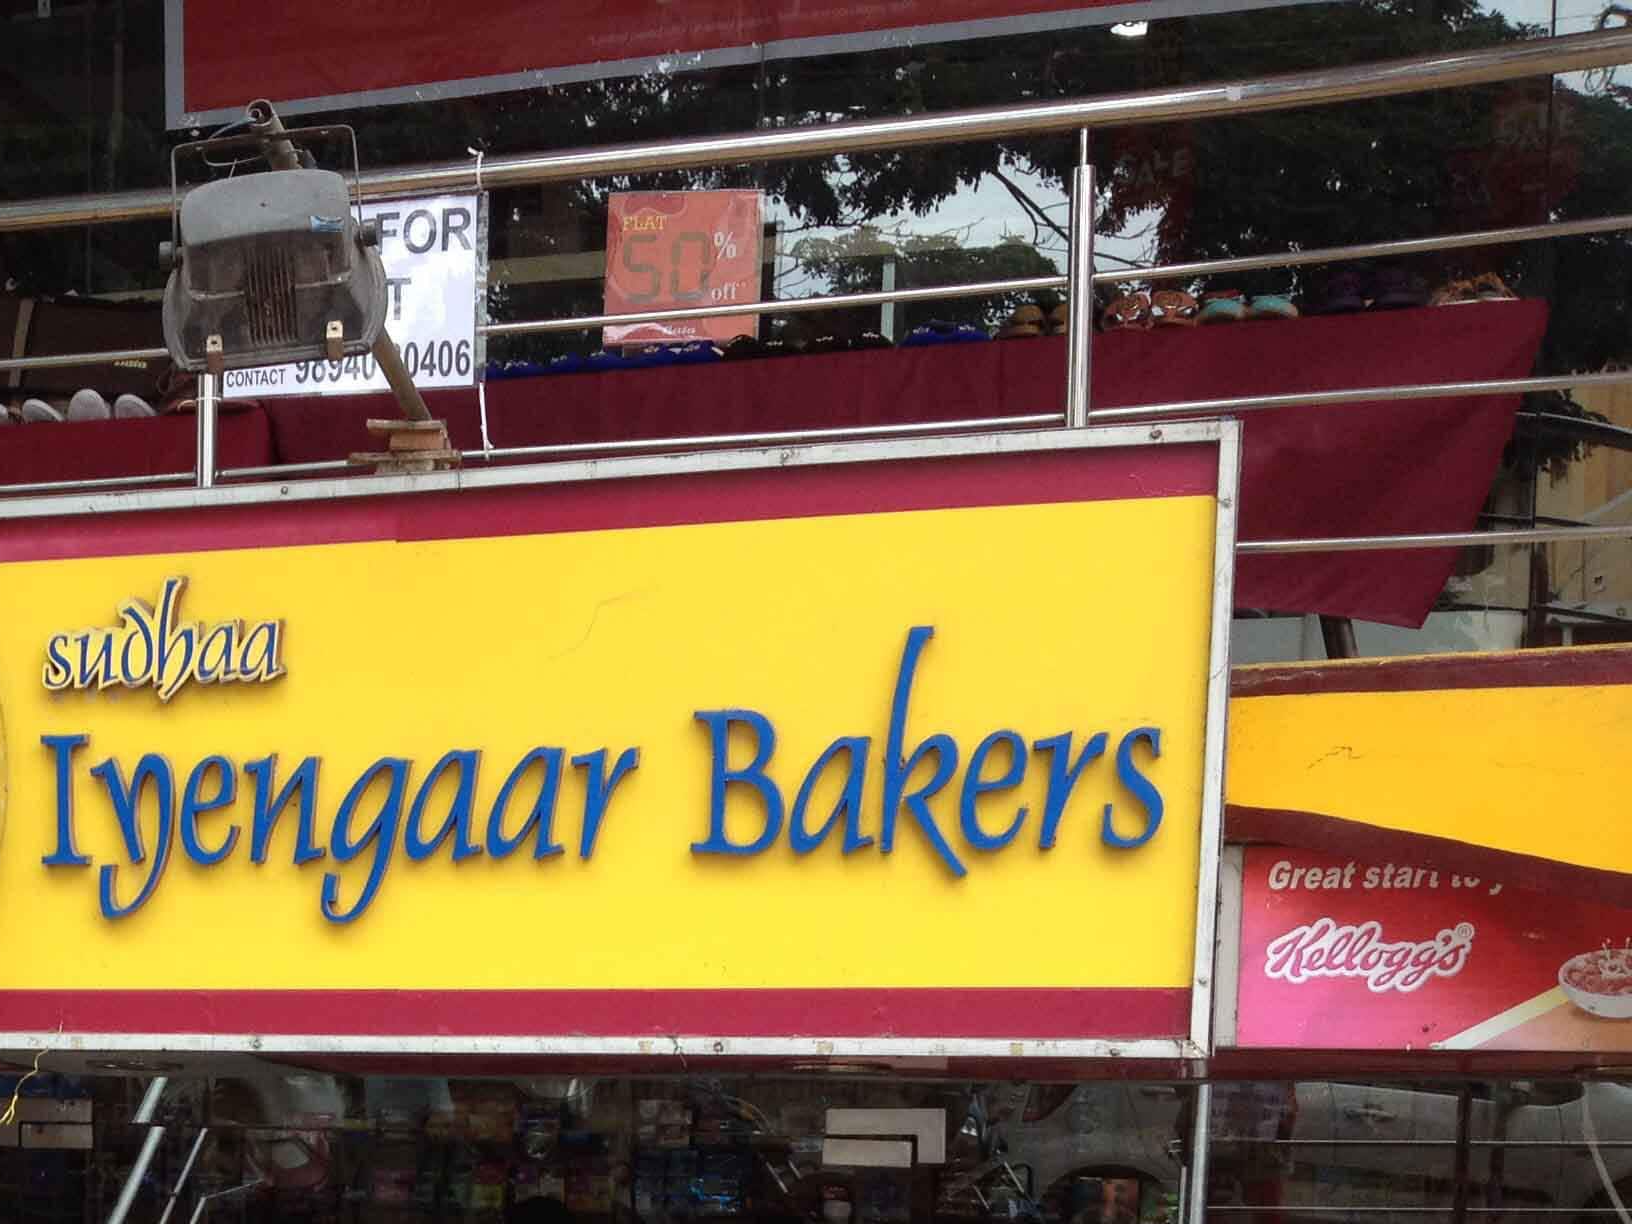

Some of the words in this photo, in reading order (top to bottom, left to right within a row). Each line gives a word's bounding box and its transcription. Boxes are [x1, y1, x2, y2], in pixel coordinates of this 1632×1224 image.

[375, 207, 473, 254] FOR
[623, 217, 666, 231] FLAT
[226, 369, 286, 388] CONTACT
[295, 339, 471, 383] 989400406
[42, 577, 286, 698] sudhaa
[40, 733, 638, 921] Iyengaar
[689, 626, 1163, 877] Bakers
[1269, 860, 1357, 890] Great
